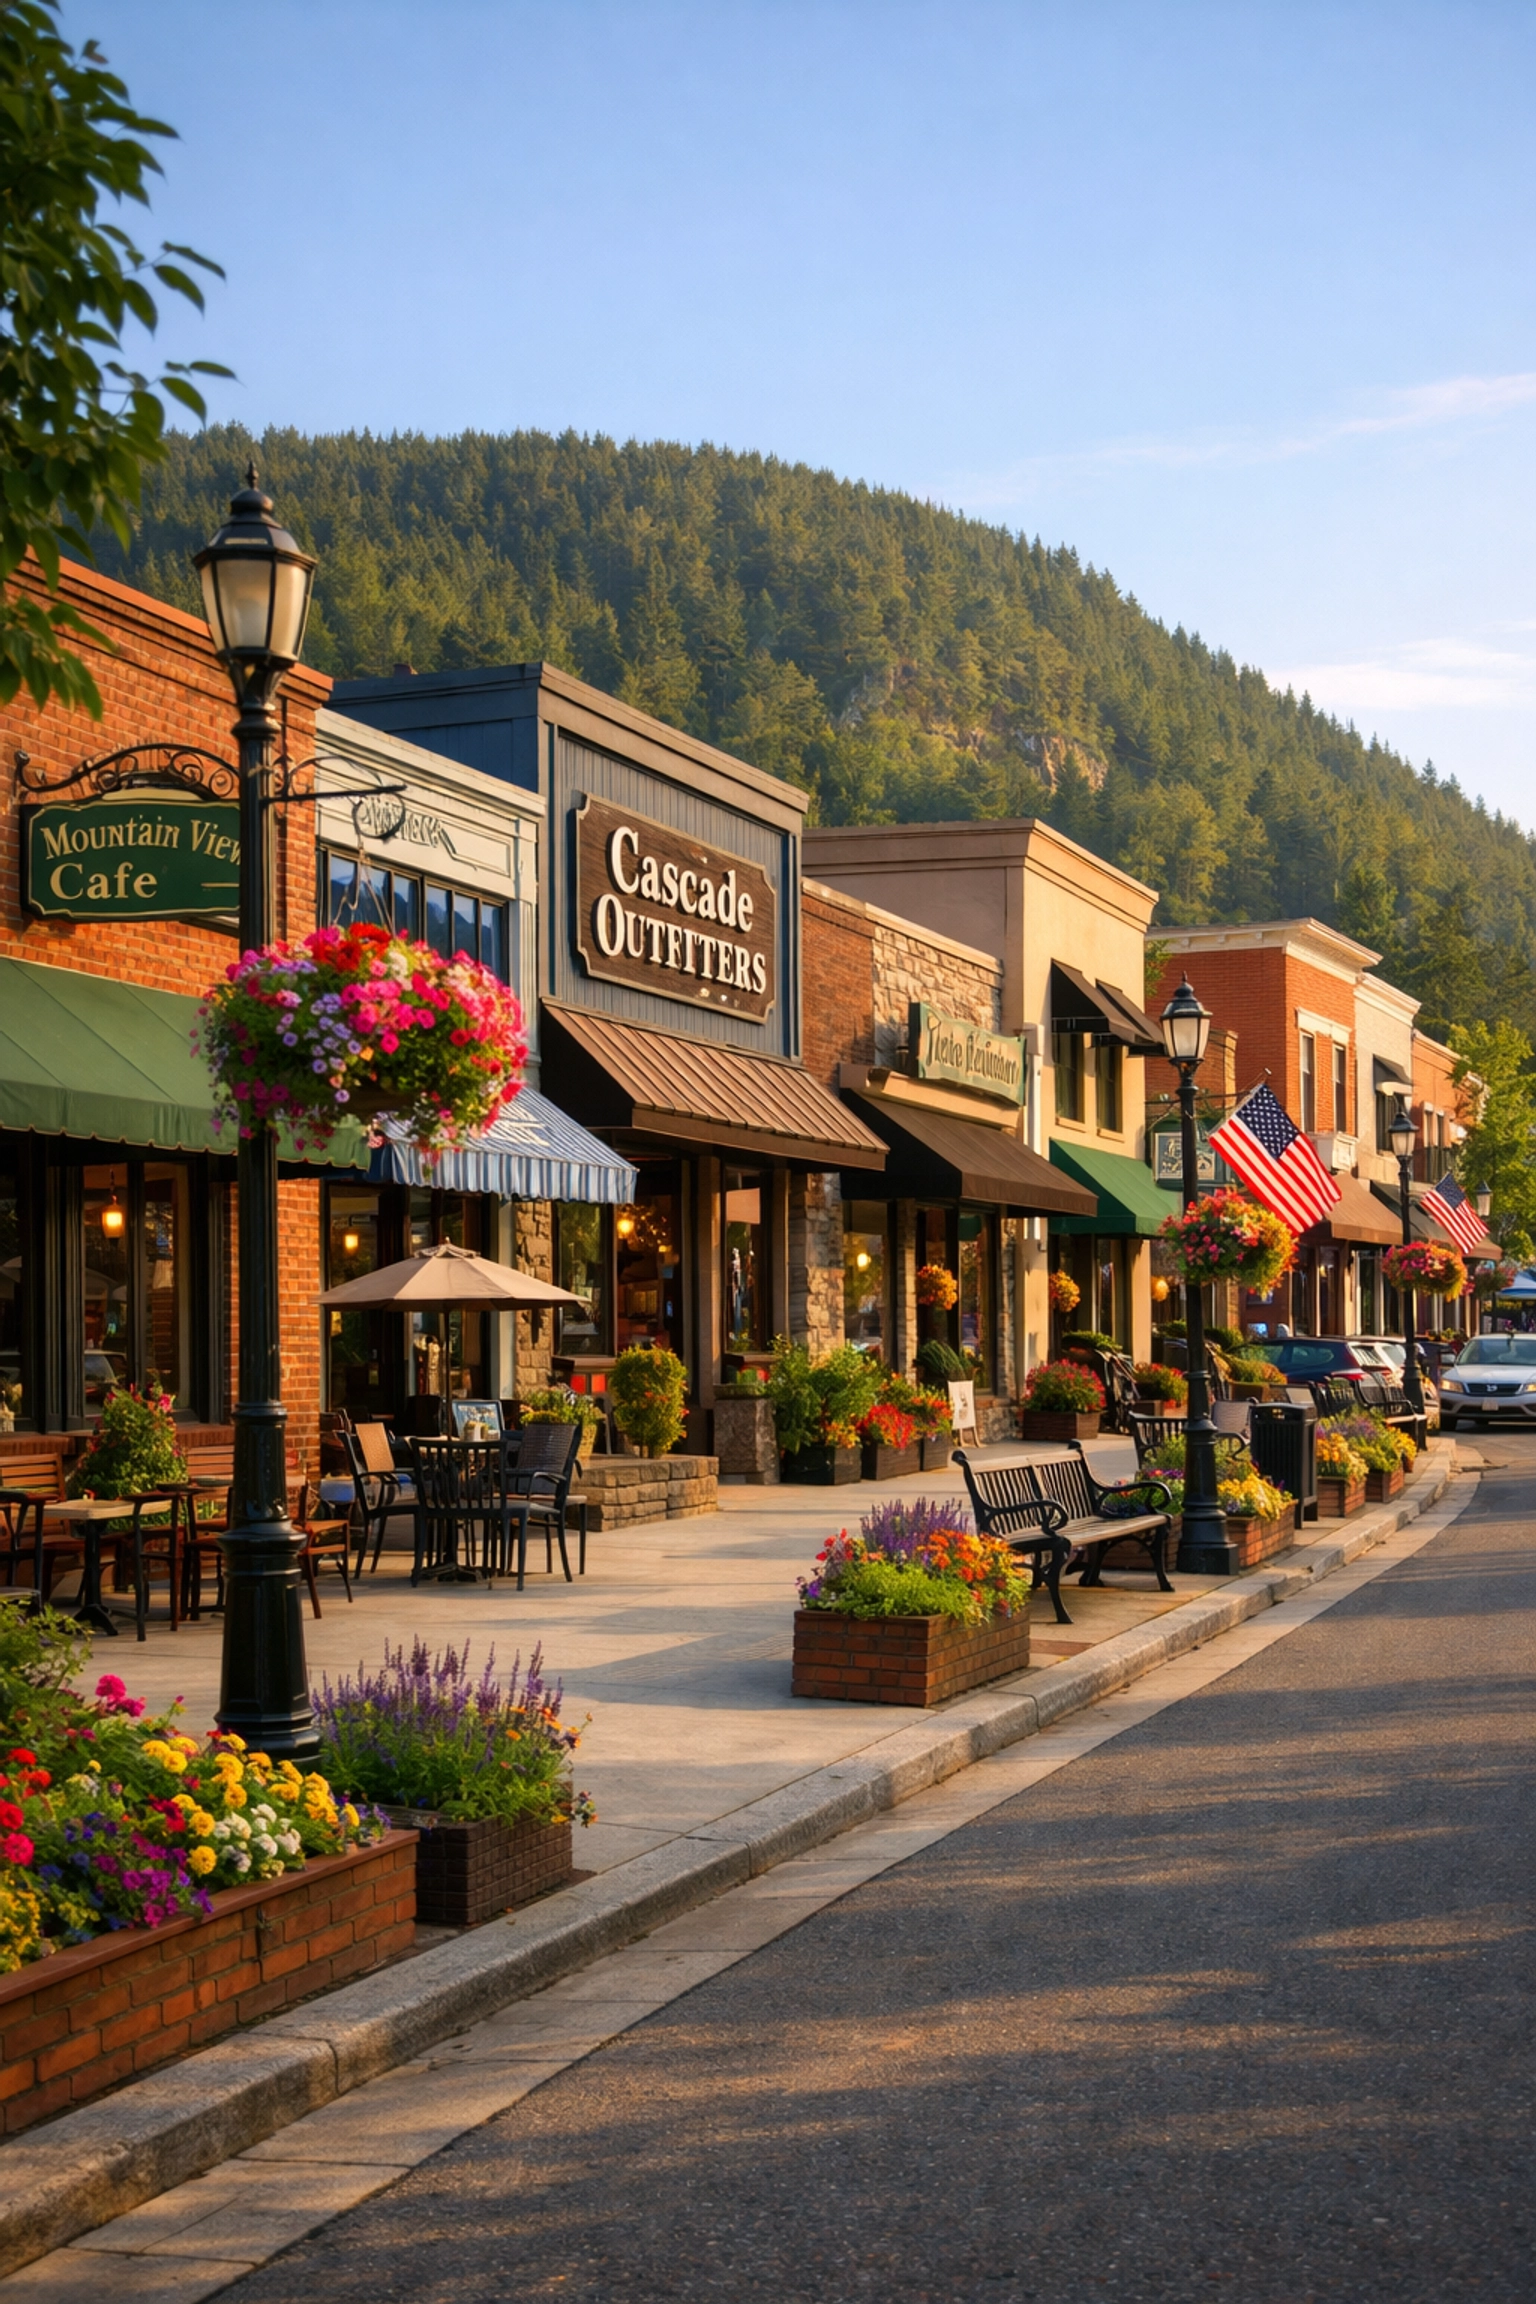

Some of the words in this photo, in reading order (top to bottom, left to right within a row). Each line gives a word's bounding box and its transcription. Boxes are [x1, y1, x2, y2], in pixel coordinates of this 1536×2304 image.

[40, 815, 180, 860] Mountain
[50, 861, 158, 900] Cafe
[611, 826, 754, 932] Cascade
